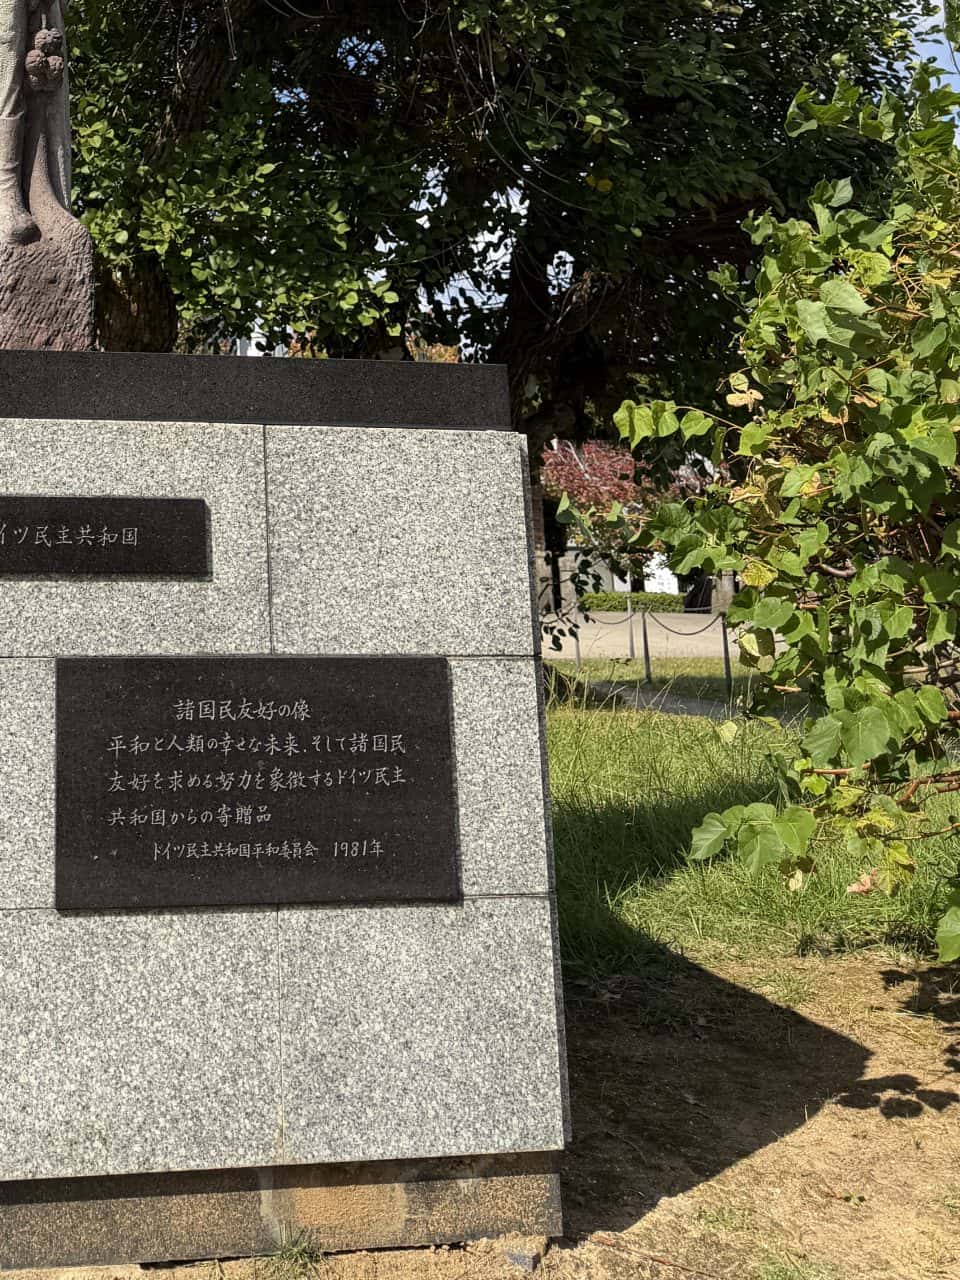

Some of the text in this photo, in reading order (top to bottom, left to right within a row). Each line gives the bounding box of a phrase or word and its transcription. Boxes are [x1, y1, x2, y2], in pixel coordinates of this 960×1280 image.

[173, 699, 312, 722] 諸国民友好の像
[107, 765, 407, 792] 友好を求める努力を象徴するドイツ民主
[108, 805, 272, 828] 共和国からの寄贈品
[153, 840, 384, 861] ドイツ民主共和国平和委員会 1981年
